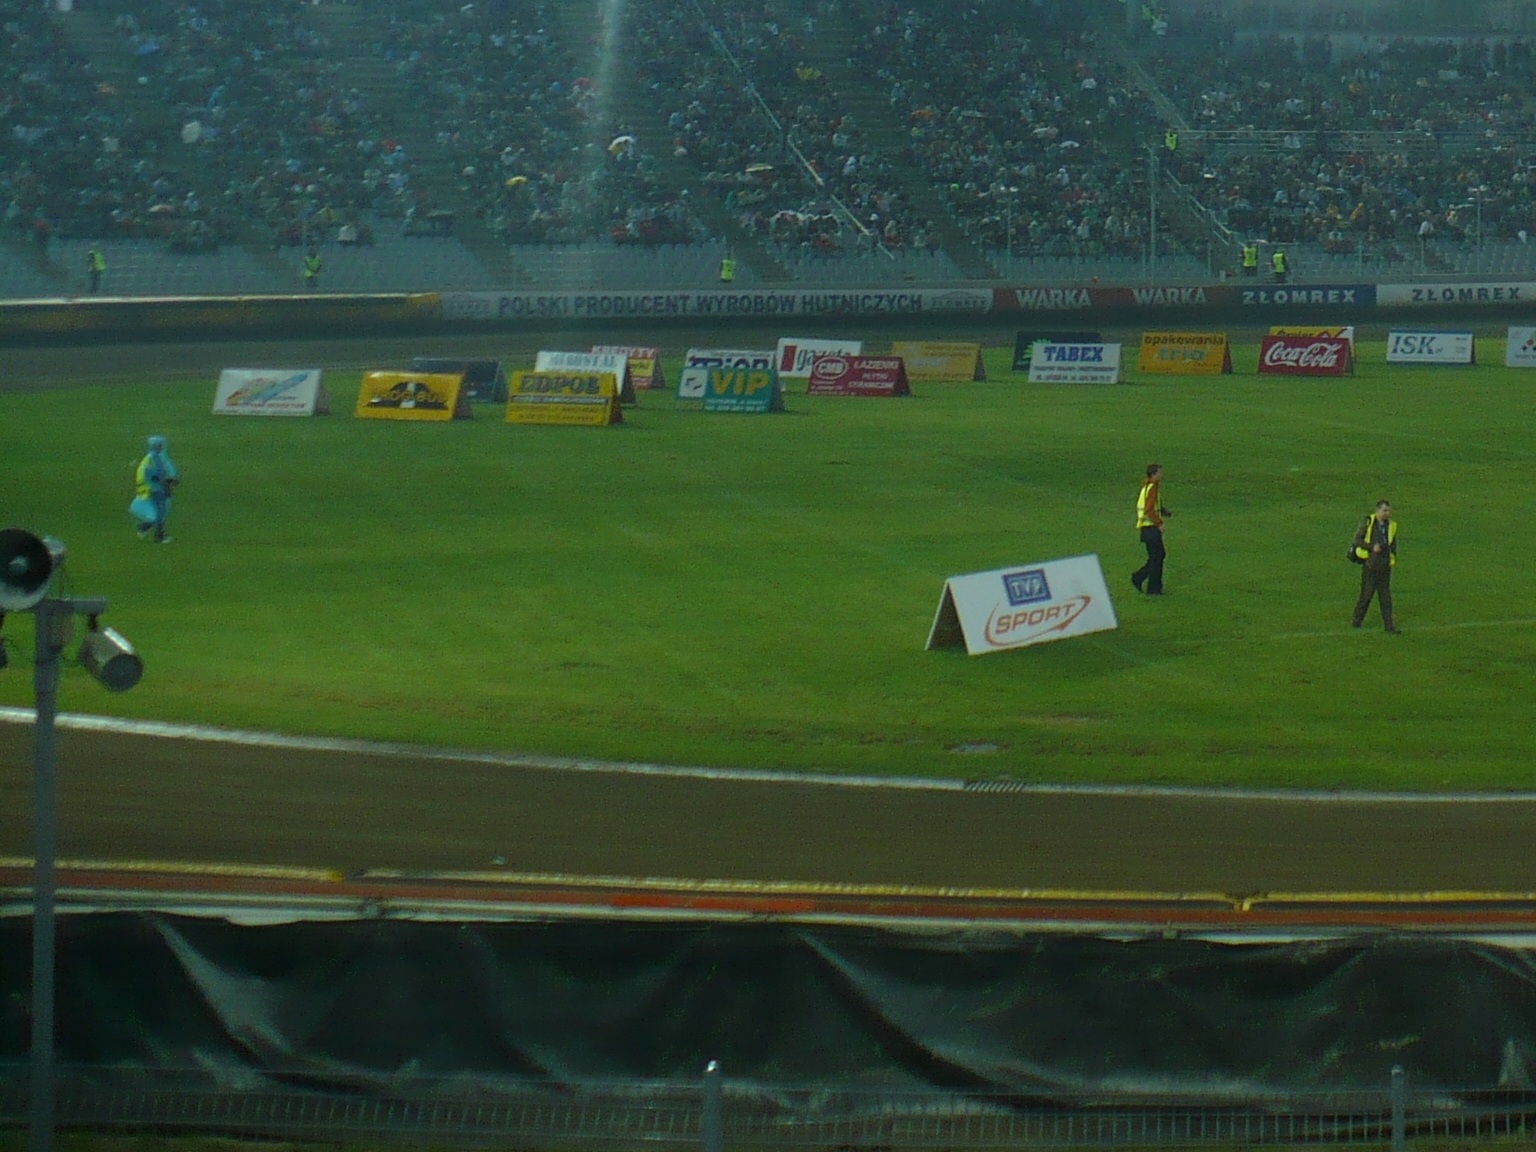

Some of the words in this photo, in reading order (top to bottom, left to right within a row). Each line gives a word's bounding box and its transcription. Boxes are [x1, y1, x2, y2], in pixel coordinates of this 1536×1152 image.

[498, 295, 568, 316] POLSKI
[574, 294, 692, 314] PRODUCENT
[696, 291, 796, 314] WYROBÓW
[801, 293, 922, 313] HUTNICZYCH
[1015, 288, 1091, 309] WARKA
[1131, 287, 1207, 305] WARKA
[1242, 289, 1355, 305] ZŁOMREX
[1412, 286, 1521, 302] ZŁOMREX
[1144, 334, 1223, 346] opakowania
[1391, 335, 1435, 355] ISK
[1043, 346, 1104, 363] TABEX
[711, 370, 770, 396] VIP
[1010, 579, 1043, 599] TVP
[994, 603, 1076, 635] SPORT
